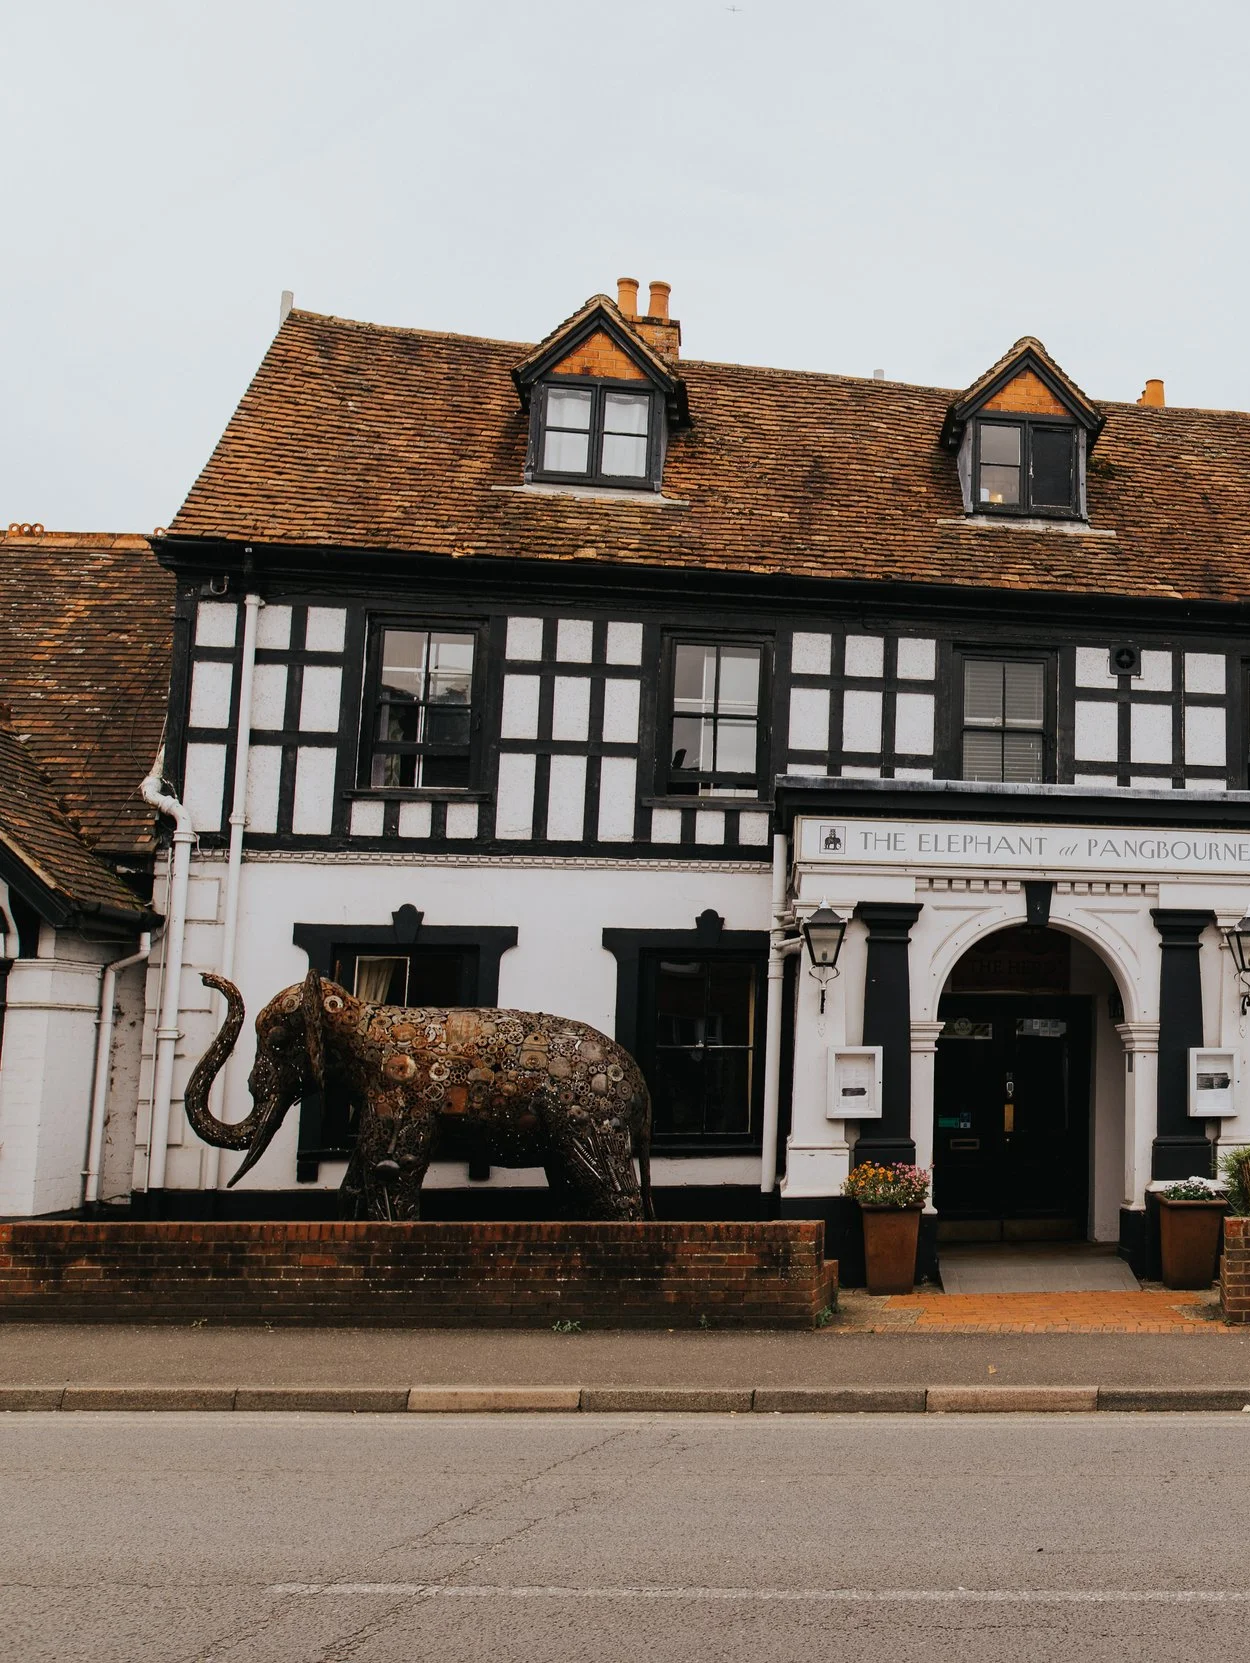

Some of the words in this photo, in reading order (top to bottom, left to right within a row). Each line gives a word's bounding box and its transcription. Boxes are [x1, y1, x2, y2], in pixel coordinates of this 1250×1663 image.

[860, 832, 906, 852] THE
[918, 833, 1048, 856] ELEPHANT
[1058, 843, 1079, 857] at
[1087, 838, 1250, 862] PANGBOURNE
